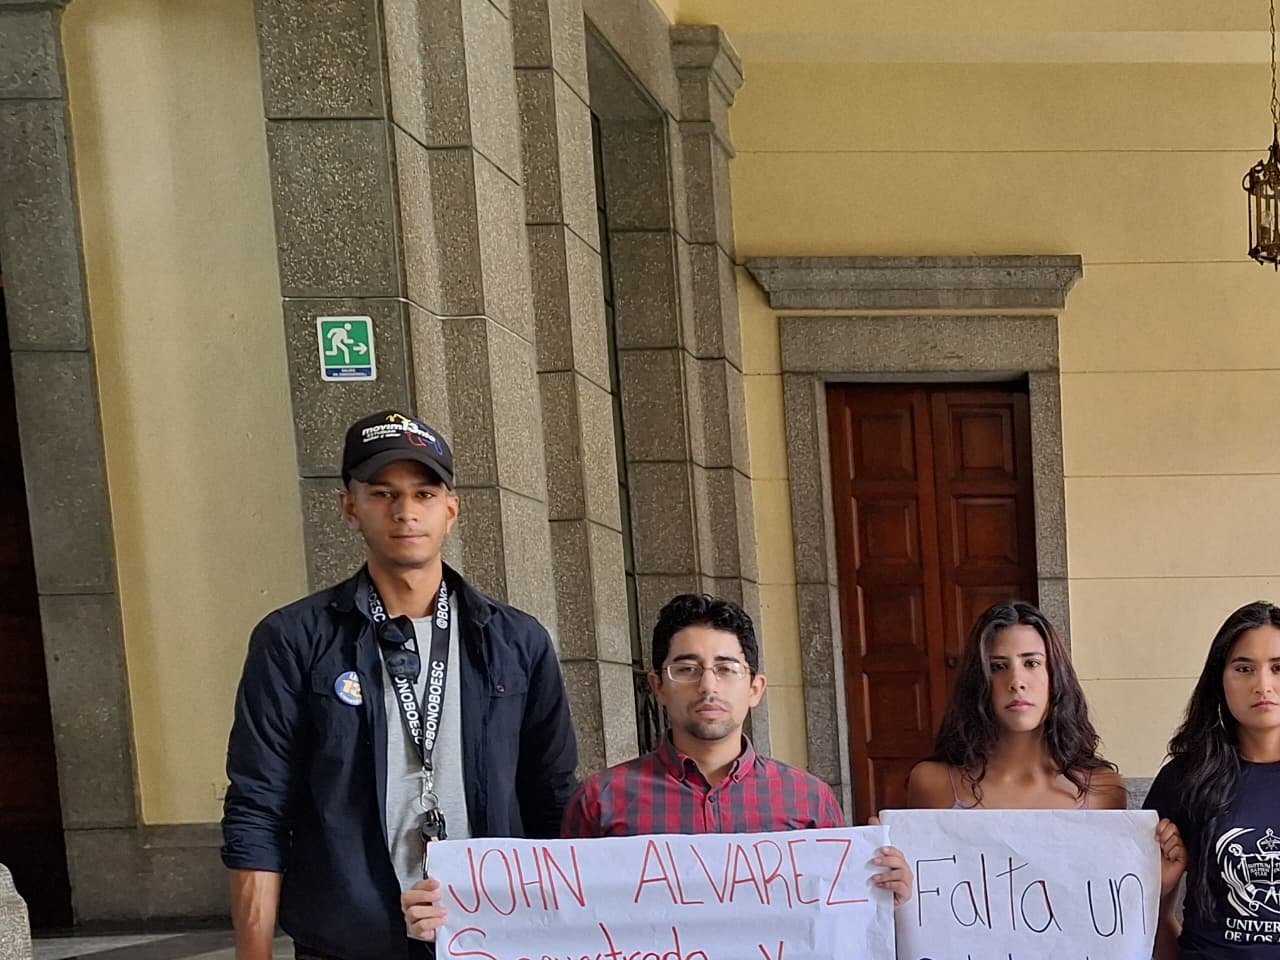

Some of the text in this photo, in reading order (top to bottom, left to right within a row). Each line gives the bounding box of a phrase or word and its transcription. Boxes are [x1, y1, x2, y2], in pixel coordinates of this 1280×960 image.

[448, 839, 869, 916] JOHN ALVAREZ
[914, 852, 1148, 938] Falta un
